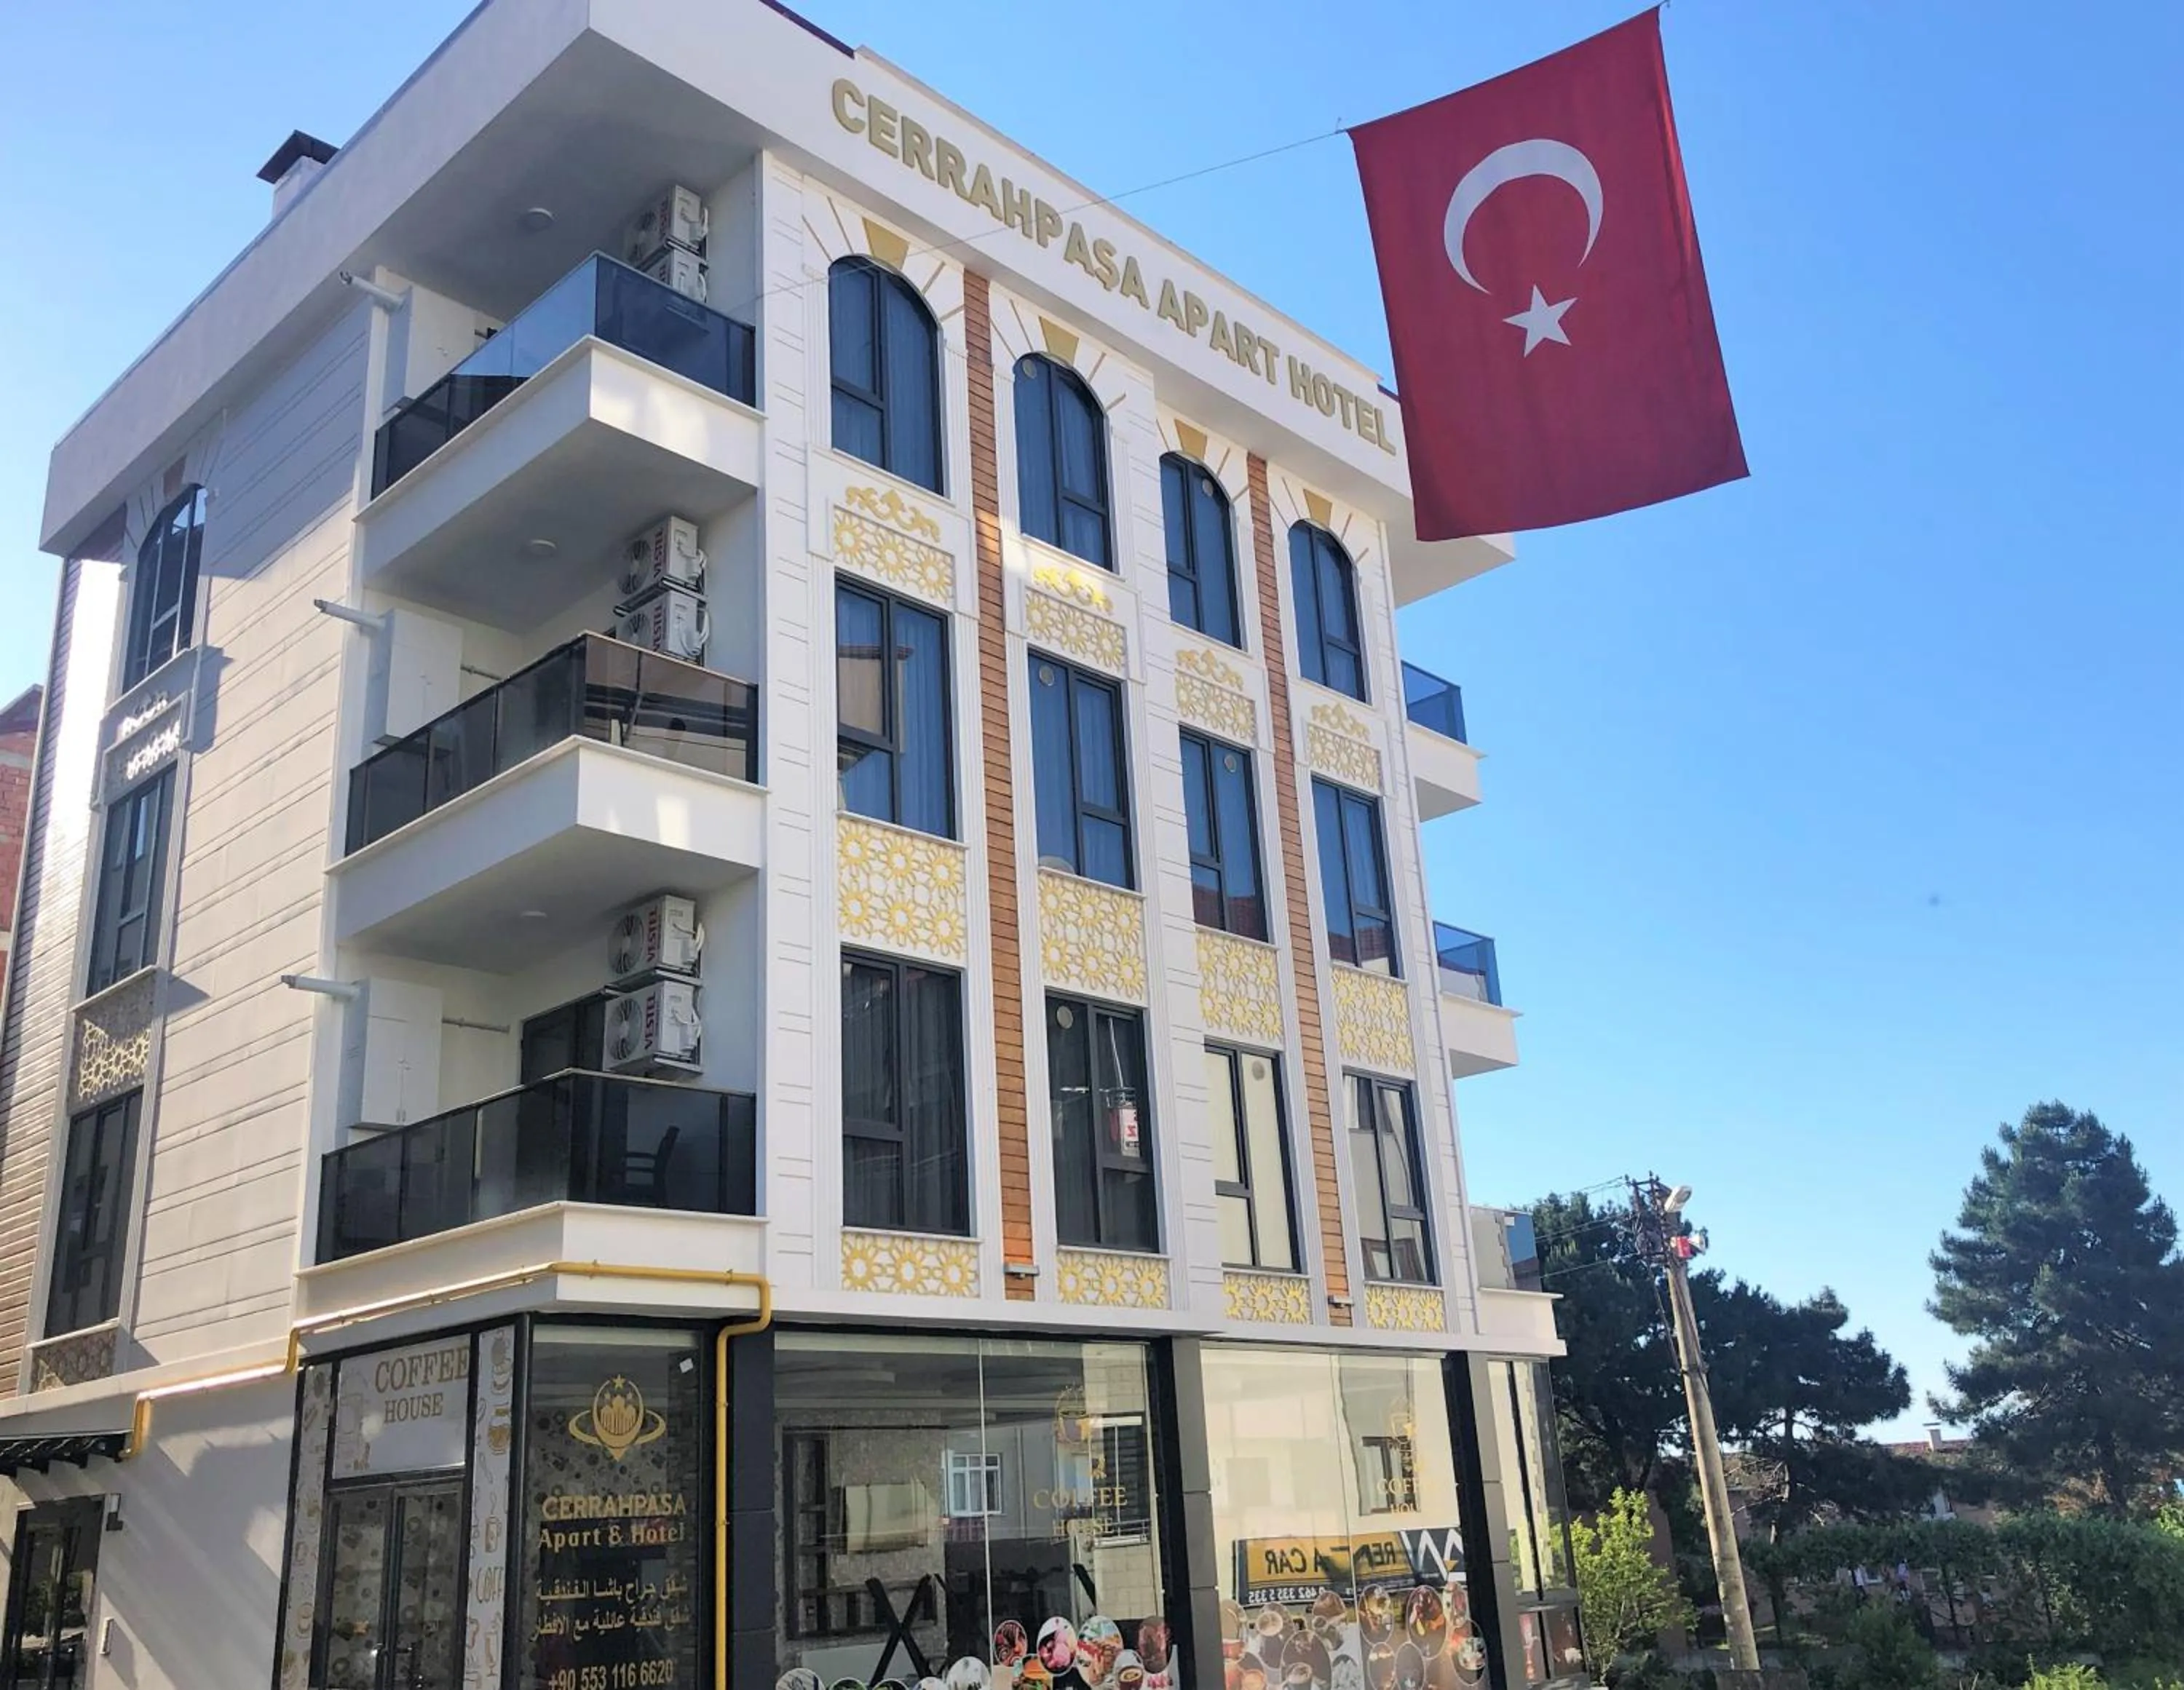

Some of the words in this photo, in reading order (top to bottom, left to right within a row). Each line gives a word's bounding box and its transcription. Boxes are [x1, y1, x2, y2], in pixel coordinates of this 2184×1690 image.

[832, 78, 1150, 309] CERRAHPAŞA
[1158, 278, 1280, 385] APART
[1288, 355, 1396, 456] HOTEL
[647, 906, 657, 962] VESTEL
[644, 992, 655, 1050] VESTEL
[375, 1346, 470, 1393] COFFEE
[384, 1392, 444, 1424] HOUSE
[539, 1528, 601, 1553] Apart
[608, 1525, 622, 1545] &
[630, 1522, 684, 1544] Hotel
[593, 1576, 623, 1601] باشا
[625, 1577, 656, 1603] جراح
[572, 1618, 590, 1641] مع
[549, 1668, 577, 1690] +90
[580, 1665, 607, 1690] 553
[612, 1662, 636, 1689] 116
[640, 1659, 673, 1684] 6620
